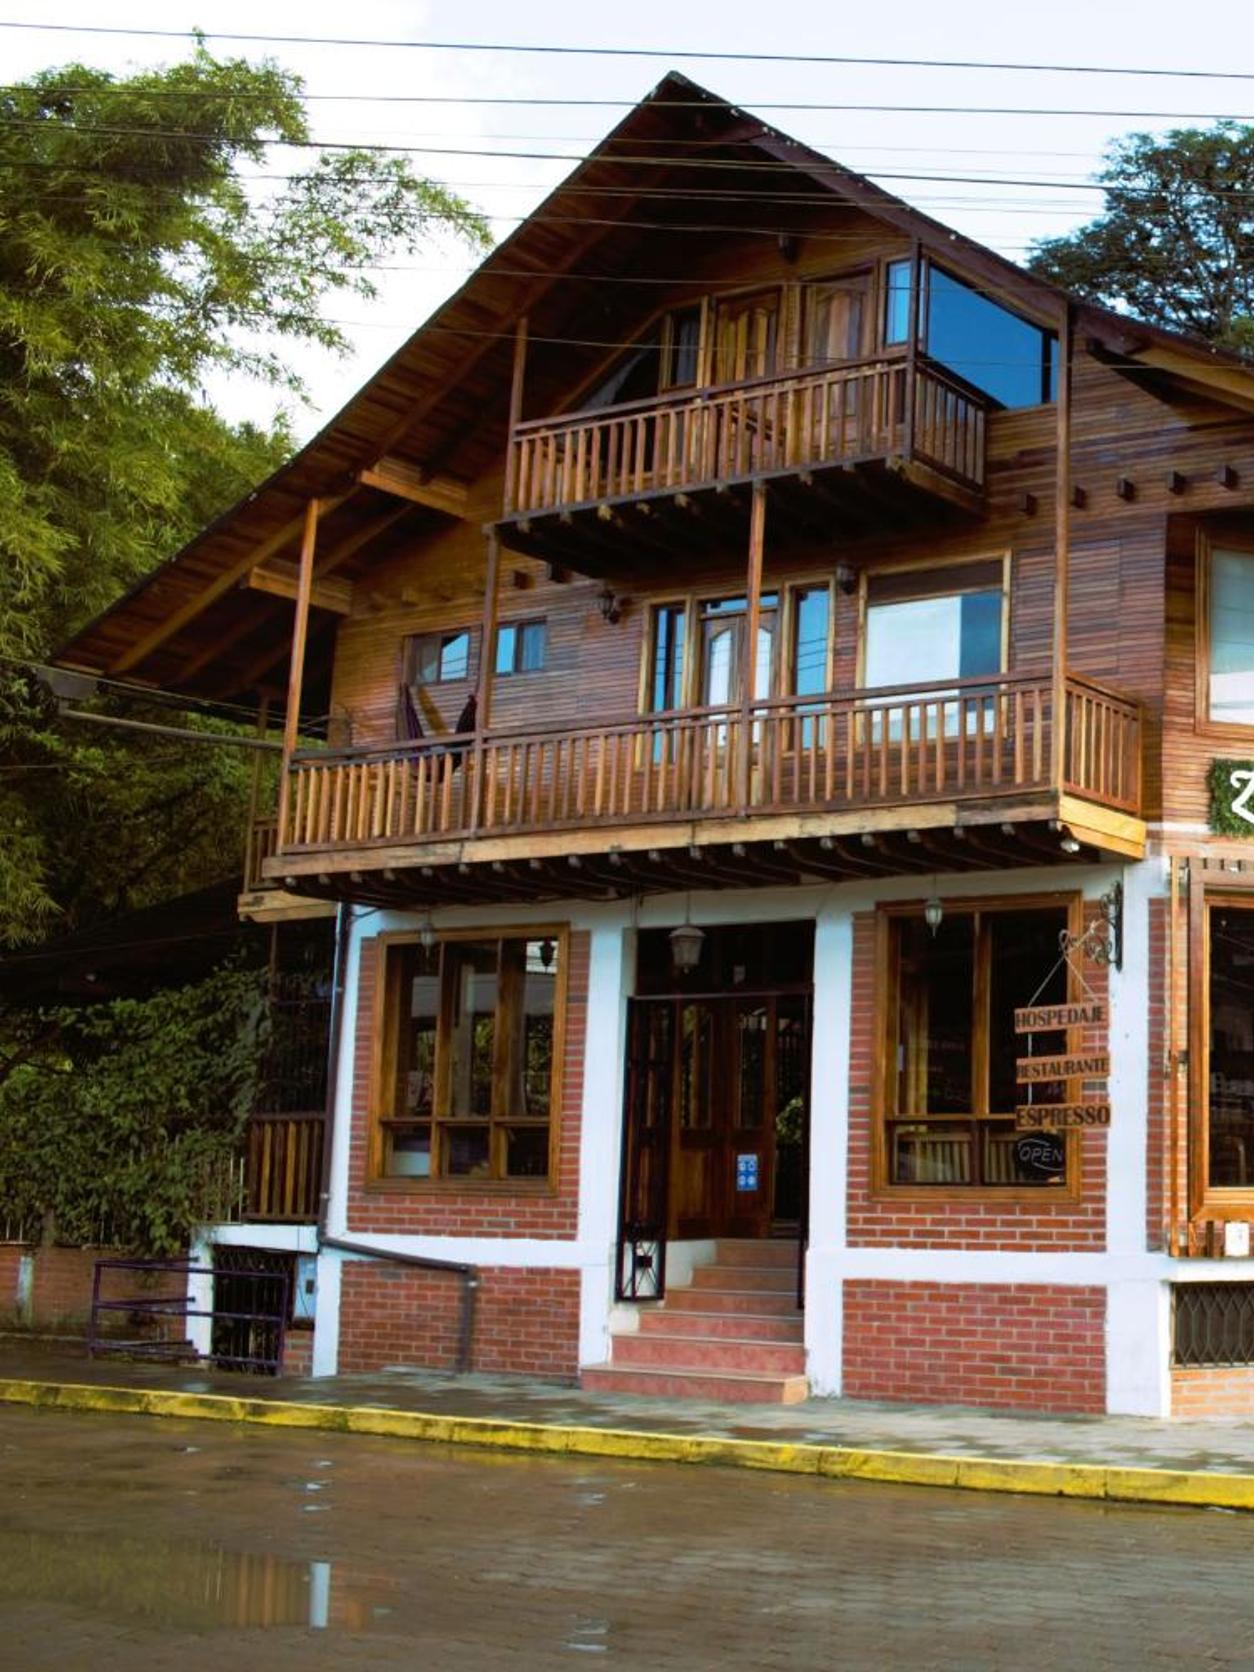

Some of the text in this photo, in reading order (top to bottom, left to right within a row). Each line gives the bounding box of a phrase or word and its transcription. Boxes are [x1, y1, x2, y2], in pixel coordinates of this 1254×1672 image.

[1016, 1007, 1106, 1027] HOSPEDAJE
[1018, 1059, 1108, 1079] RESTAURANTE
[1017, 1106, 1110, 1126] ESPRESSO
[1020, 1147, 1063, 1162] OPEN
